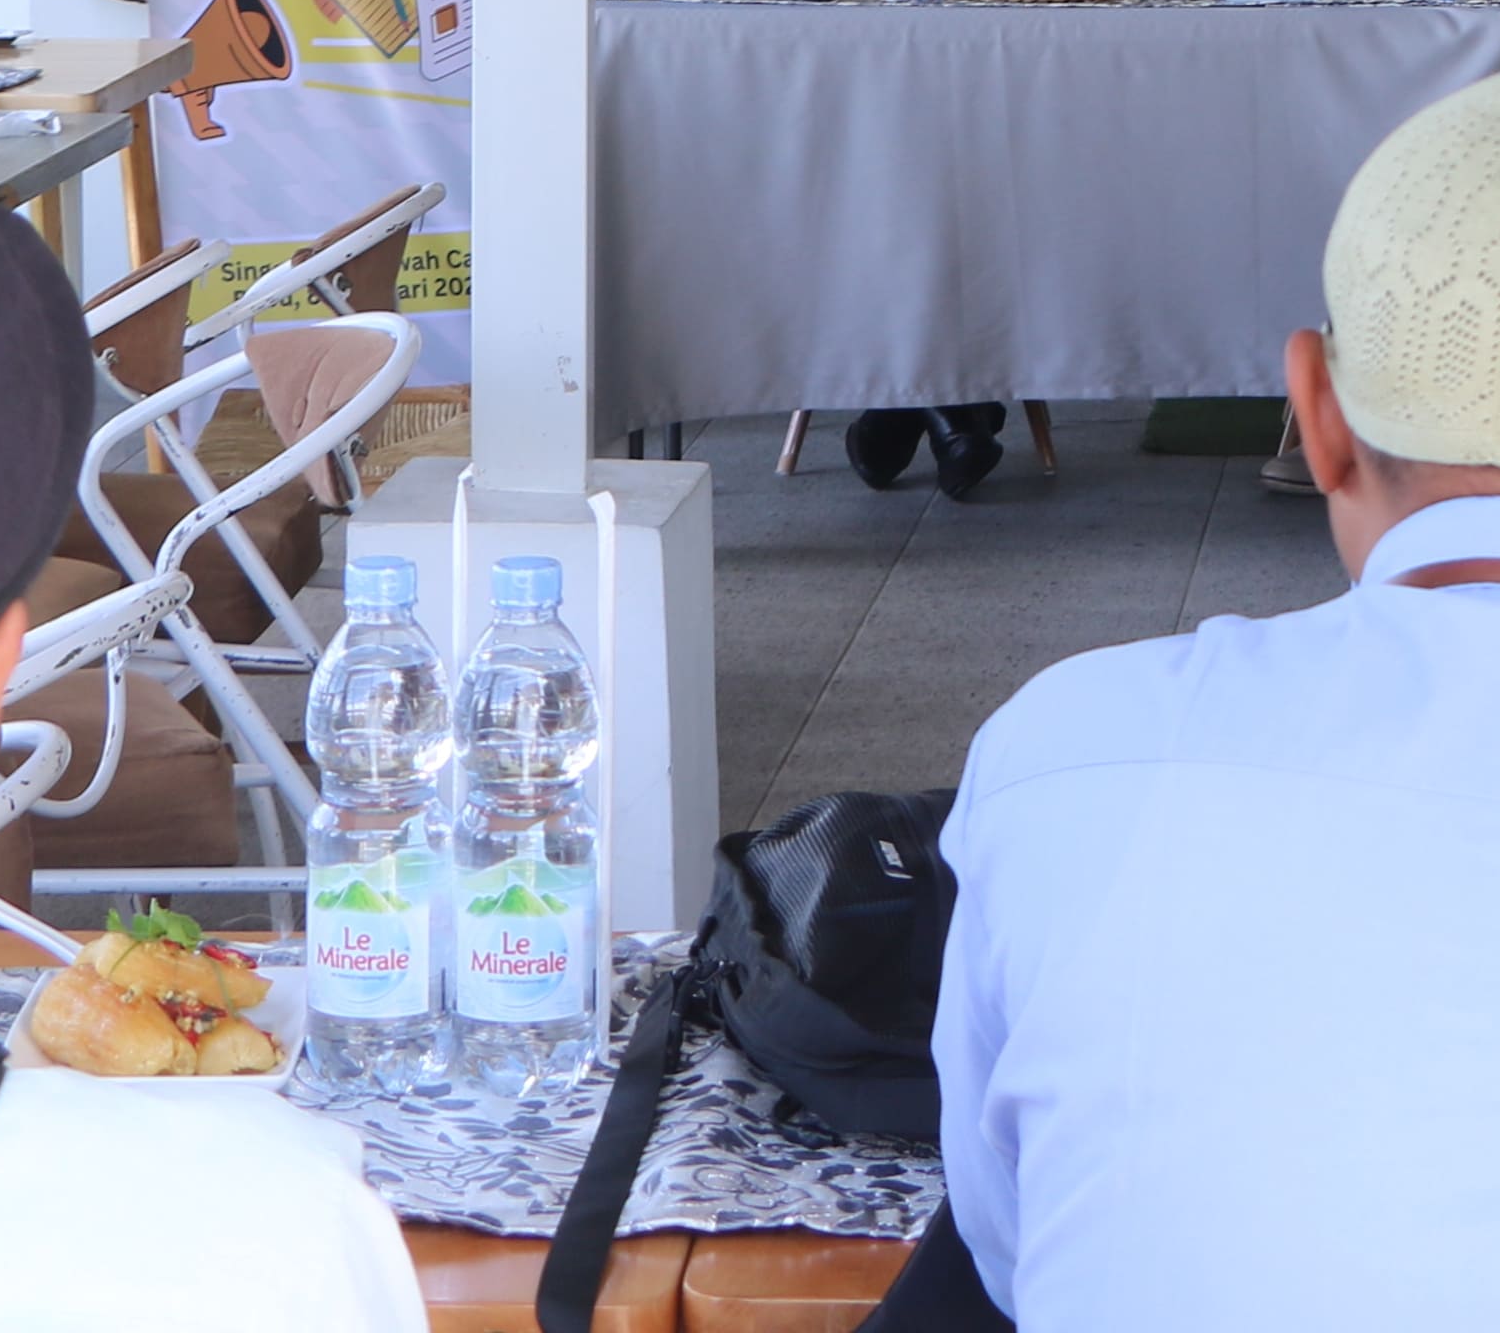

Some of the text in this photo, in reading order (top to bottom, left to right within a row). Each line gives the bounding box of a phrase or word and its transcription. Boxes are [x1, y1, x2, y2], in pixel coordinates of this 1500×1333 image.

[344, 926, 371, 951] Le
[503, 931, 531, 955] Le
[317, 943, 410, 971] Minerale
[471, 949, 568, 976] Minerale
